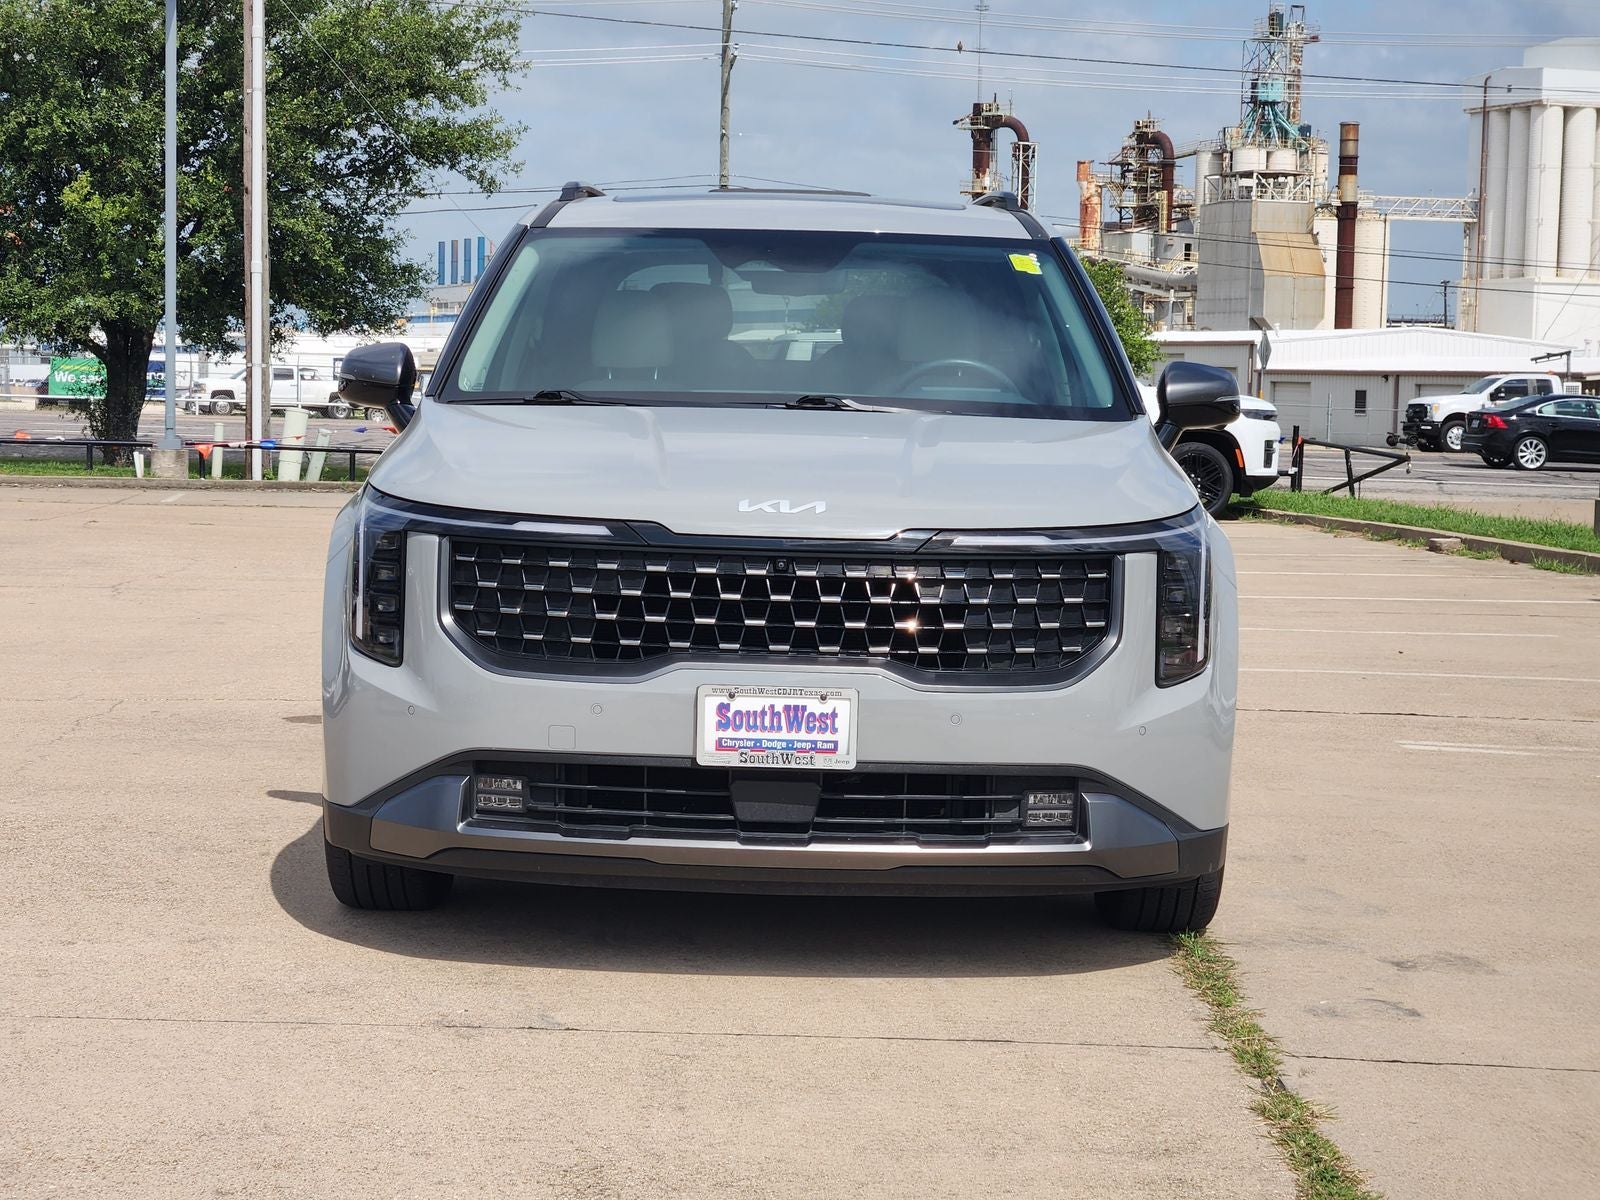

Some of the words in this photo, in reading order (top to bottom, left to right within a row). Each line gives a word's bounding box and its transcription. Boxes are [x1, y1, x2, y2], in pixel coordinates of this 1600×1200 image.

[54, 370, 77, 383] We
[738, 499, 826, 514] KIA
[711, 687, 842, 697] wwwSouthWestCDJRTexascom
[715, 701, 838, 735] SouthWest
[721, 738, 755, 749] Chrysler
[761, 739, 787, 750] Dodge
[793, 740, 812, 750] Jeep
[816, 740, 835, 750] Ram
[739, 751, 816, 766] SouthWest
[833, 758, 850, 766] Jeep
